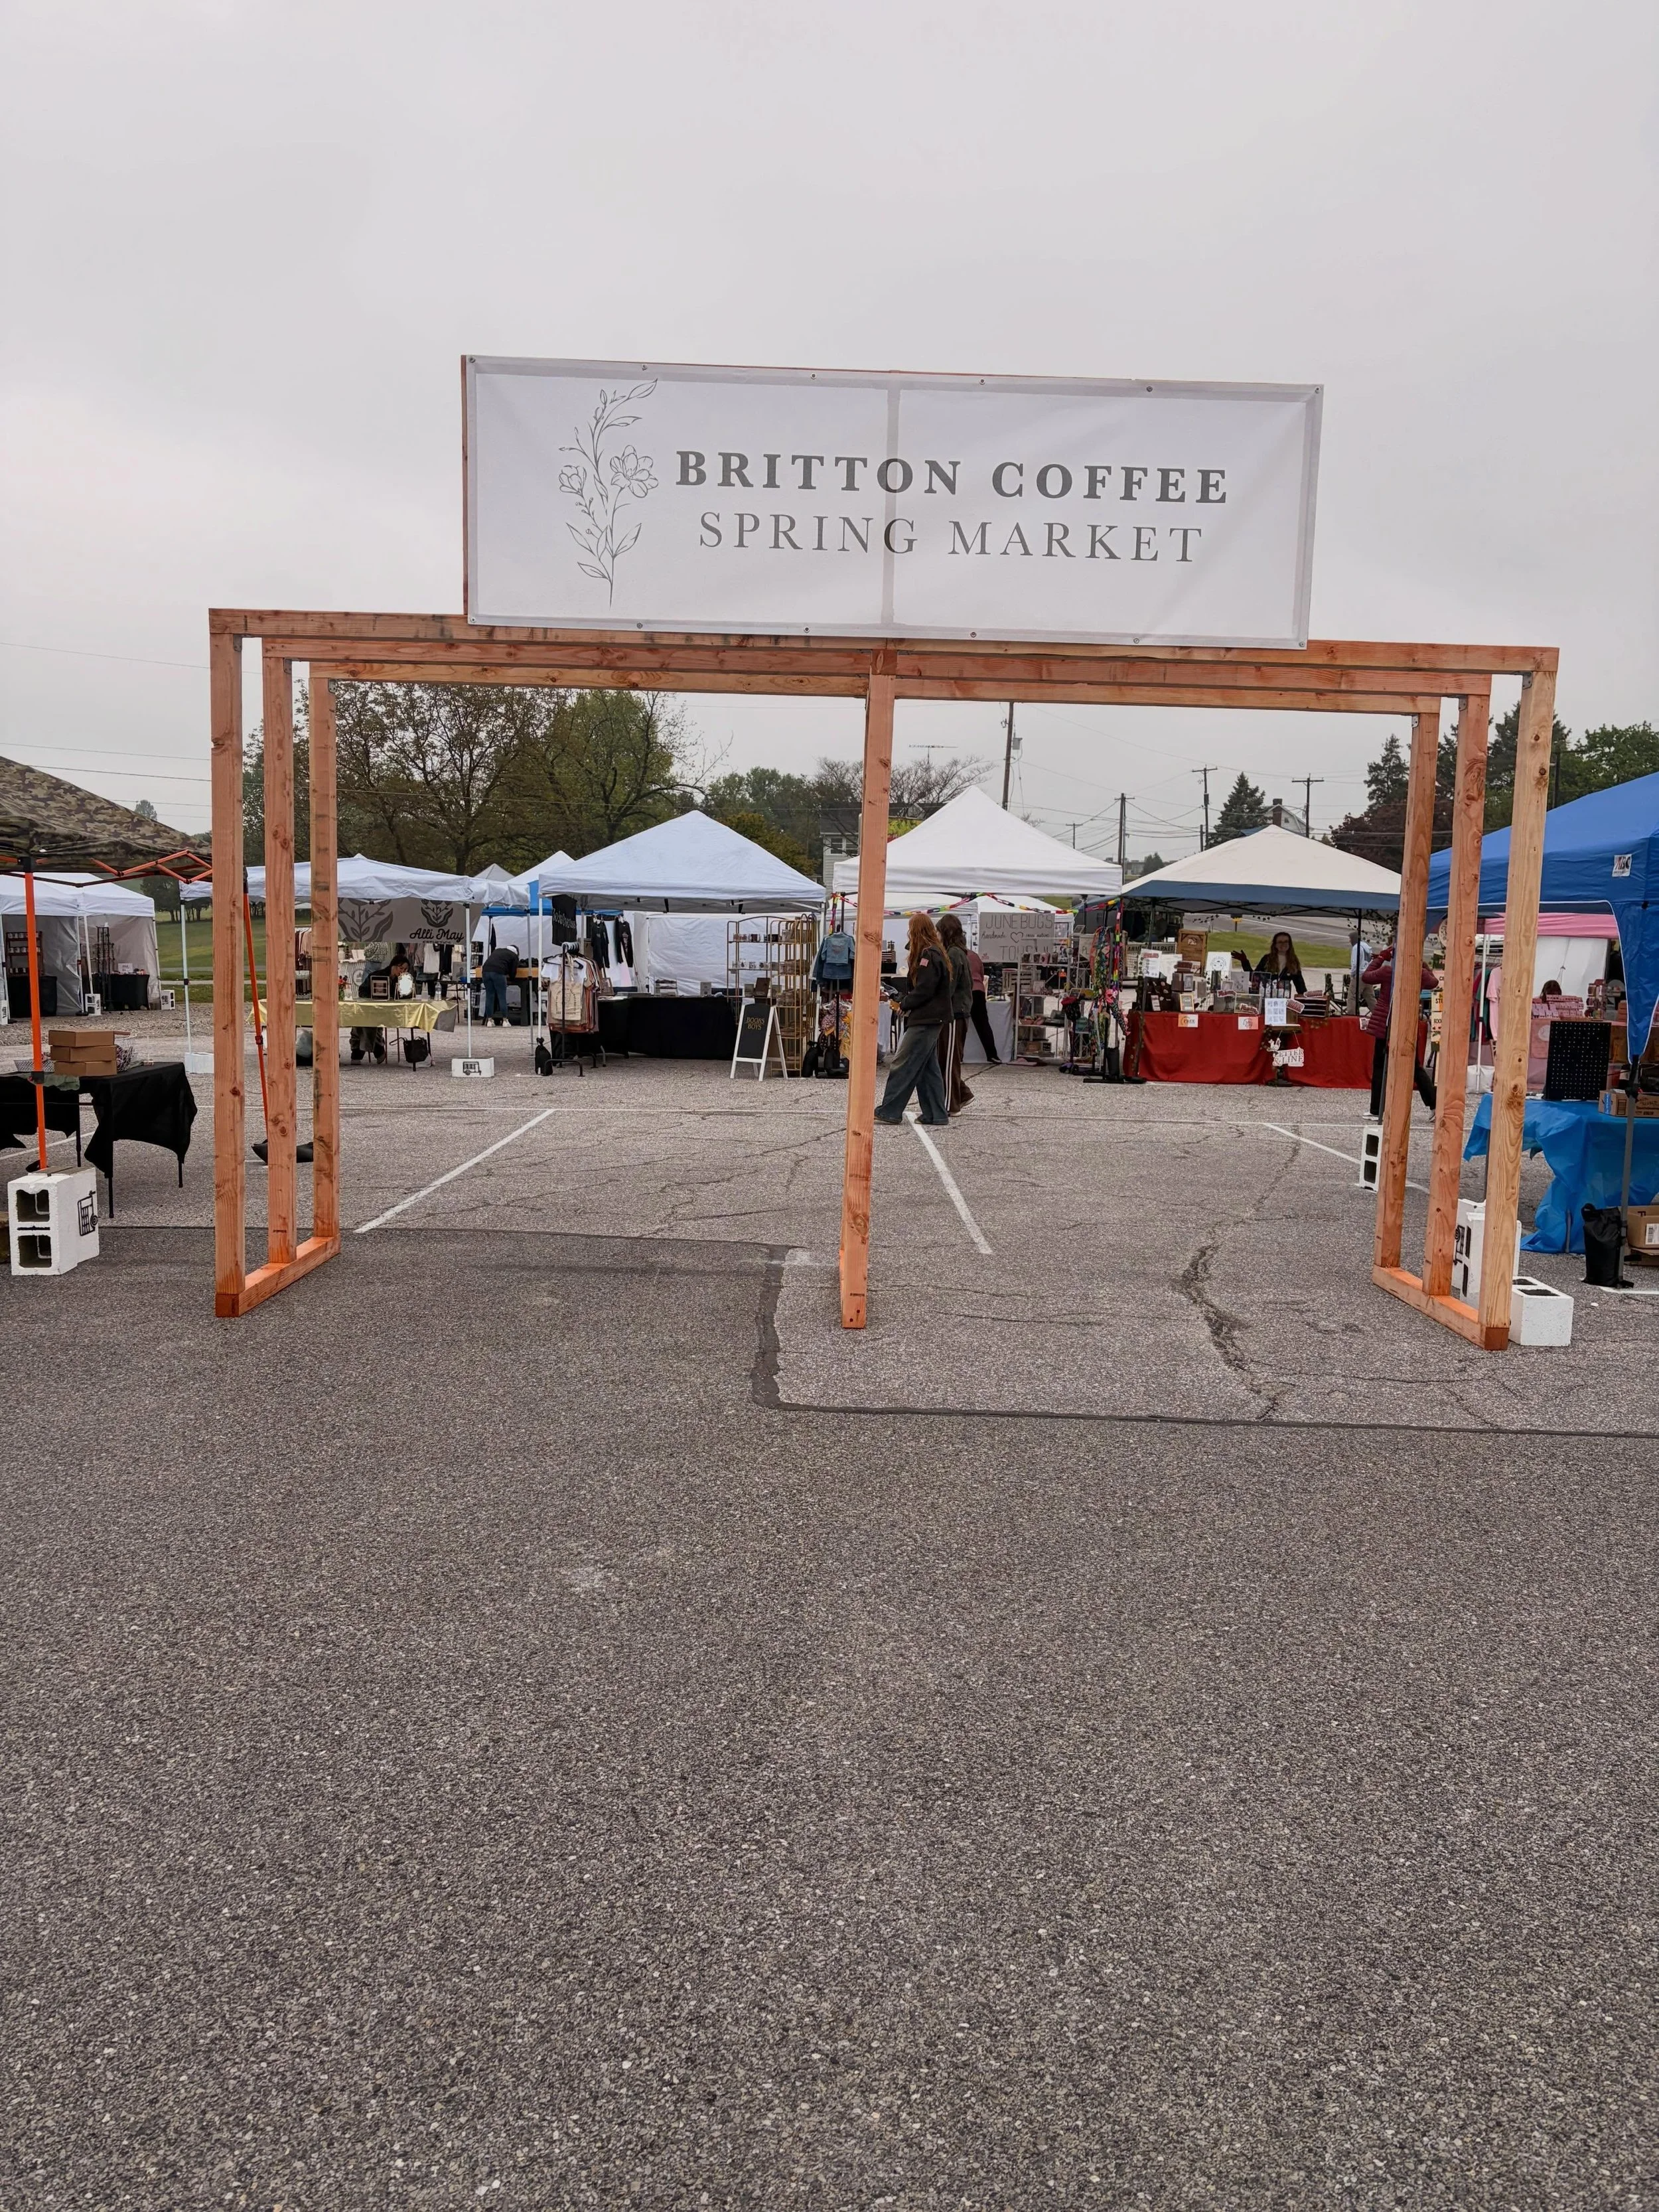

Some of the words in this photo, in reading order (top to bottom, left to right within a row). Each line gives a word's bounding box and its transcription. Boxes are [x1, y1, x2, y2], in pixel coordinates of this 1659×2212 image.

[676, 451, 961, 495] BRITTON
[992, 462, 1226, 503] COFFEE
[700, 512, 918, 553] SPRING
[948, 520, 1202, 561] MARKET
[409, 928, 434, 939] Alli
[436, 928, 464, 942] May
